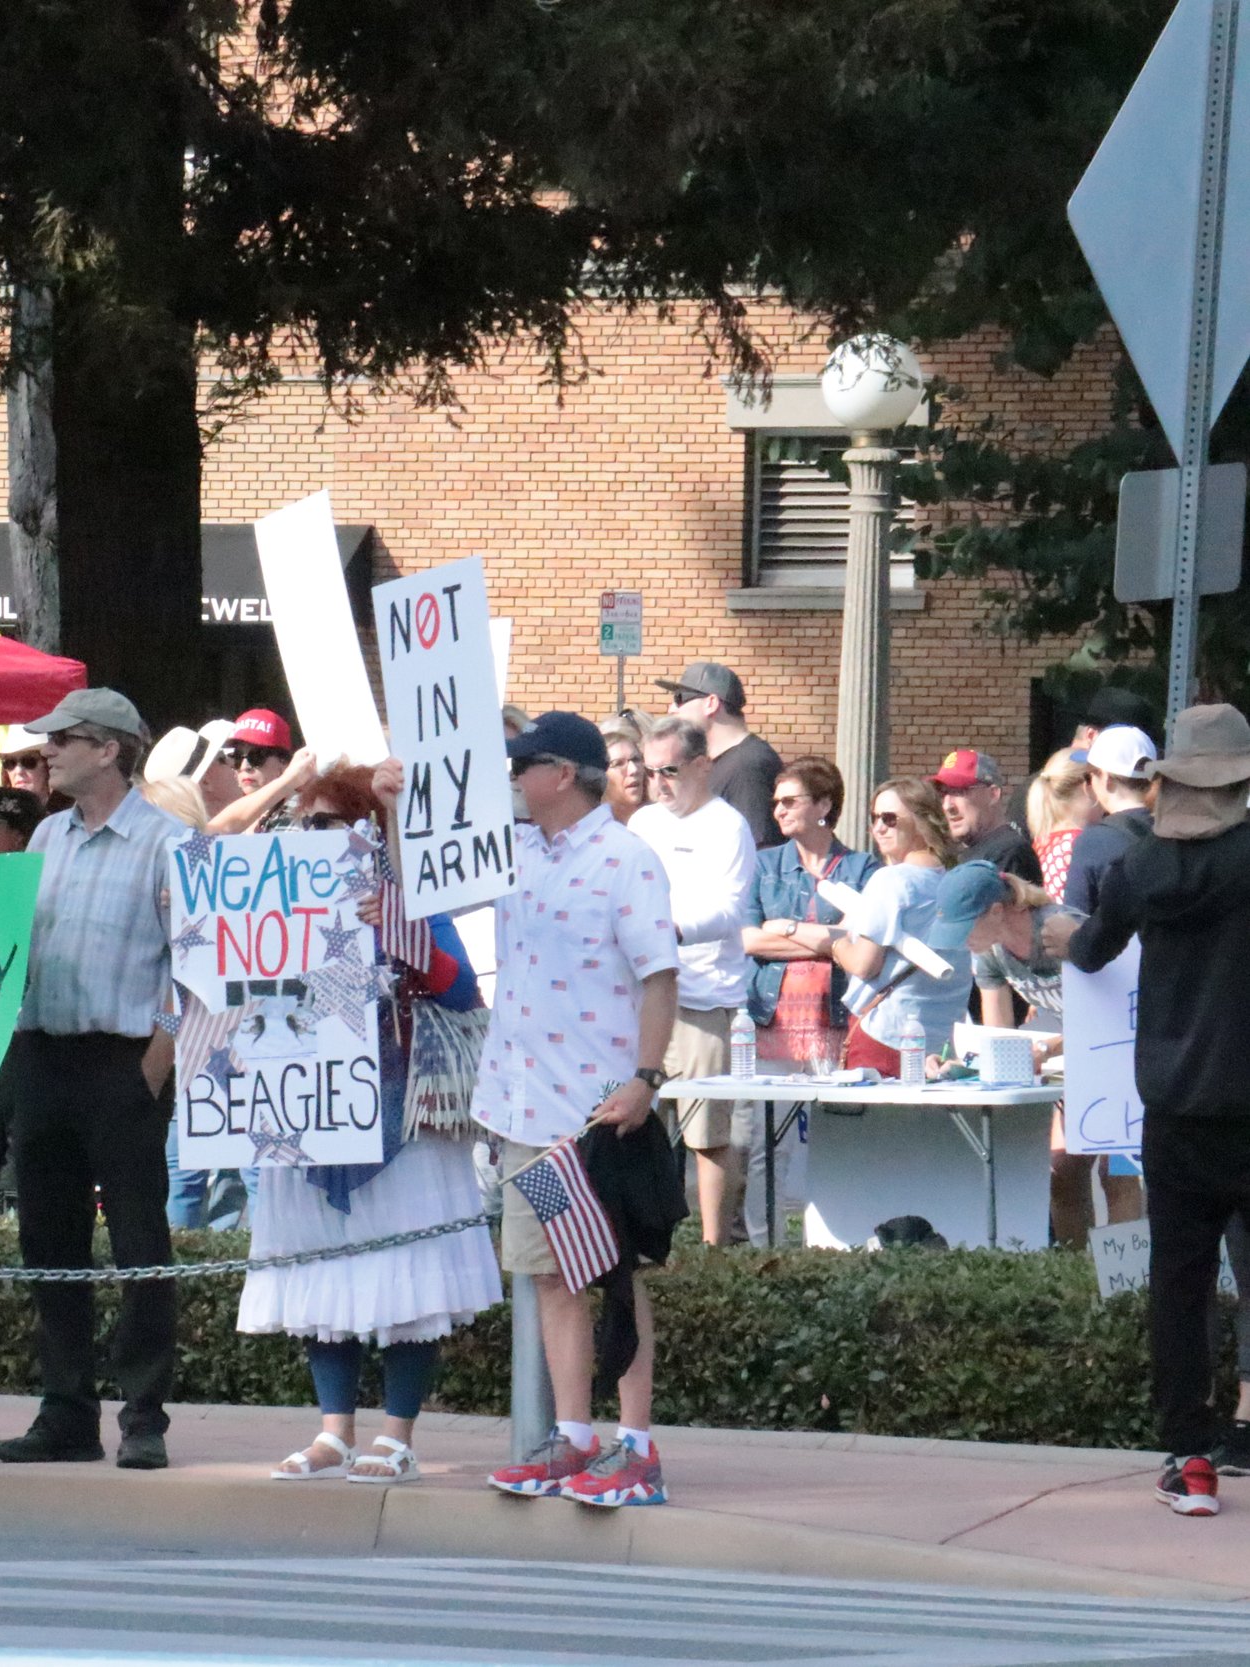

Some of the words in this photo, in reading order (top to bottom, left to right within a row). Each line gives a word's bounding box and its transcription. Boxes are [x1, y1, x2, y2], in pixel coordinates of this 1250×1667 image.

[390, 584, 461, 661] NOT
[234, 718, 272, 733] ASTA!
[417, 676, 458, 742] IN
[405, 749, 471, 832] MY
[174, 840, 251, 915] We
[251, 835, 342, 918] Are
[416, 823, 516, 896] ARM!
[217, 907, 329, 977] NOT
[186, 1056, 379, 1138] BEAGLES
[1103, 1237, 1126, 1260] My
[1131, 1234, 1150, 1250] Bo
[1108, 1272, 1136, 1291] My
